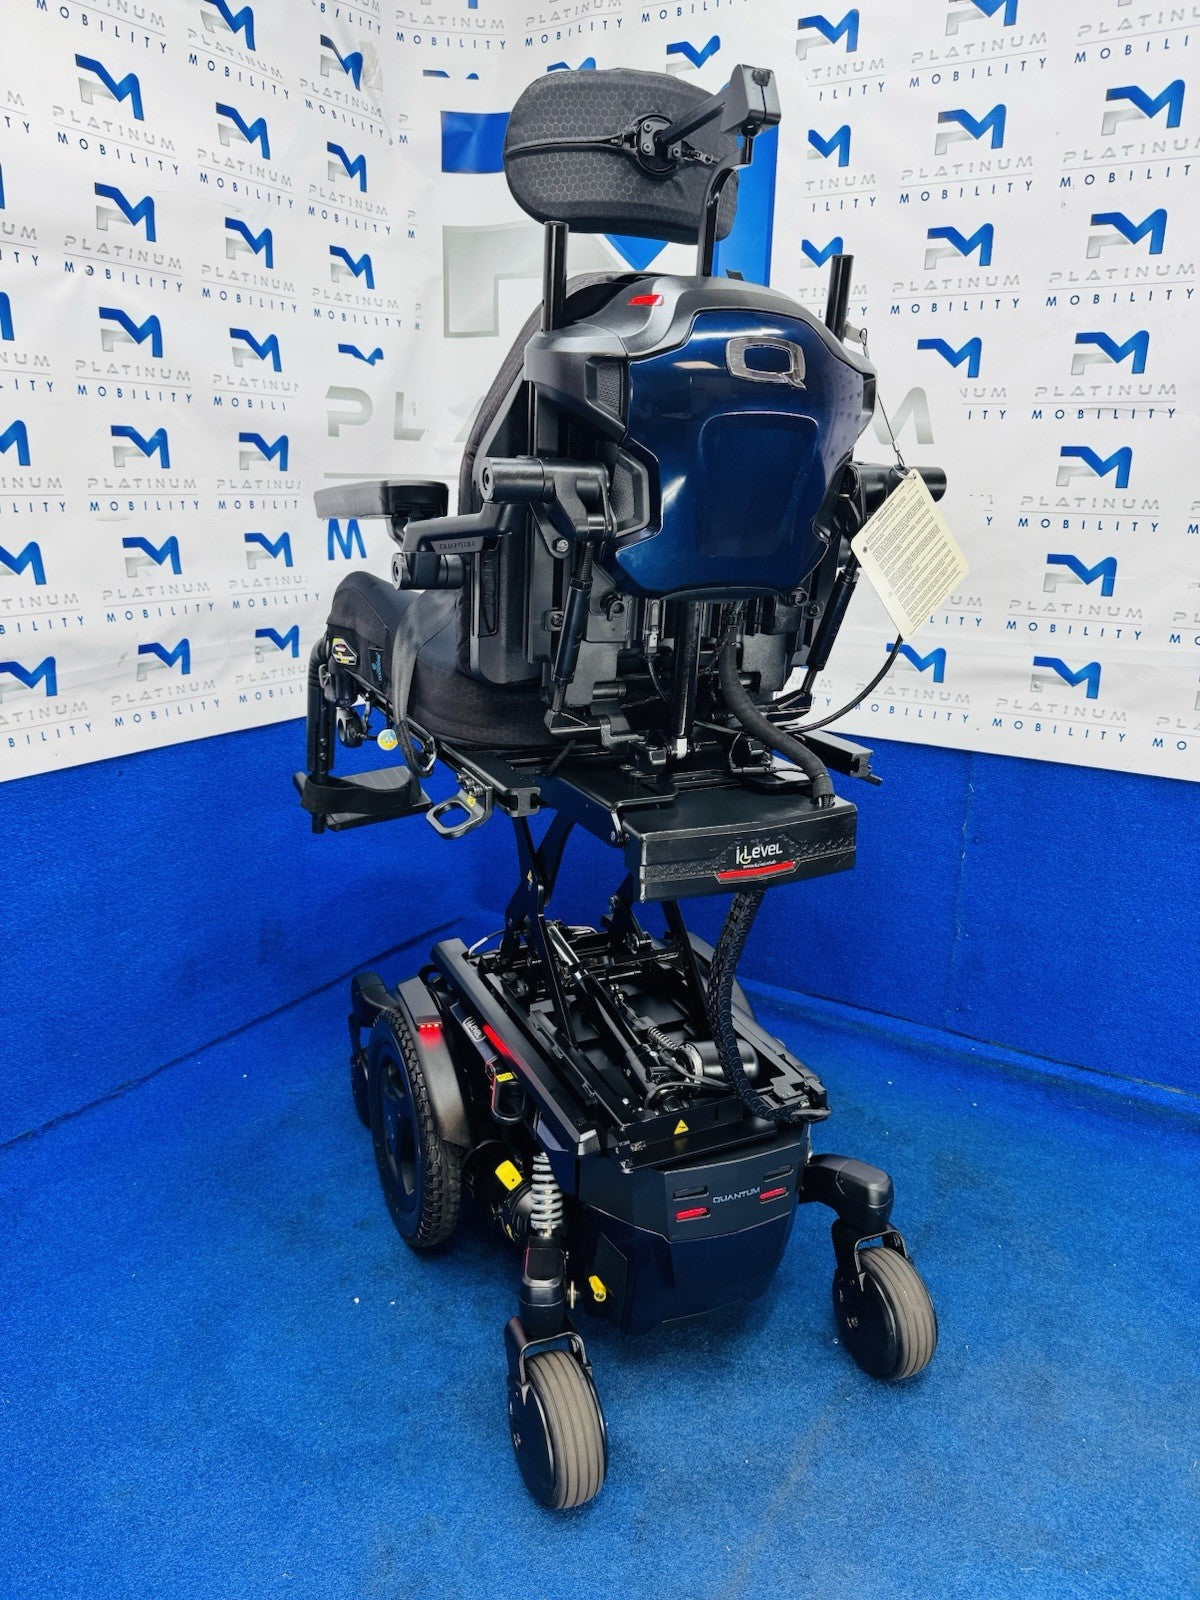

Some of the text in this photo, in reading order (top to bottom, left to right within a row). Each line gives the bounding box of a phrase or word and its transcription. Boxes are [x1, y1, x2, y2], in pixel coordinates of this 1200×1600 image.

[36, 0, 167, 54] MOBILITY
[395, 9, 505, 30] PLATINUM
[396, 32, 507, 50] MOBILITY
[524, 18, 623, 47] MOBILITY
[188, 28, 285, 79] PLATINUM
[911, 32, 1048, 63] PLATINUM
[188, 53, 290, 100] MOBILITY
[909, 57, 1048, 88] MOBILITY
[299, 78, 382, 118] PLATINUM
[52, 105, 176, 151] PLATINUM
[304, 99, 383, 138] MOBILITY
[57, 131, 180, 176] MOBILITY
[197, 148, 293, 187] PLATINUM
[901, 156, 1034, 180] PLATINUM
[199, 172, 294, 209] MOBILITY
[309, 184, 388, 216] PLATINUM
[899, 180, 1033, 204] MOBILITY
[308, 205, 391, 235] MOBILITY
[64, 235, 182, 270] PLATINUM
[64, 261, 183, 293] MOBILITY
[201, 264, 295, 292] PLATINUM
[891, 274, 1021, 293] PLATINUM
[1049, 262, 1196, 283] PLATINUM
[201, 287, 298, 314] MOBILITY
[312, 287, 400, 309] PLATINUM
[890, 298, 1020, 315] MOBILITY
[1046, 288, 1194, 307] MOBILITY
[313, 308, 402, 327] MOBILITY
[75, 359, 191, 382] PLATINUM
[77, 384, 193, 404] MOBILITY
[1034, 384, 1177, 397] PLATINUM
[1031, 408, 1176, 419] MOBILITY
[87, 478, 197, 489] PLATINUM
[90, 500, 200, 511] MOBILITY
[1020, 496, 1160, 510] PLATINUM
[1018, 517, 1159, 533] MOBILITY
[102, 582, 211, 601] PLATINUM
[232, 593, 320, 610] MOBILITY
[106, 602, 215, 623] MOBILITY
[1009, 600, 1143, 618] PLATINUM
[1006, 620, 1141, 640] MOBILITY
[111, 679, 217, 706] PLATINUM
[114, 699, 221, 727] MOBILITY
[996, 698, 1128, 722] PLATINUM
[992, 718, 1126, 742] MOBILITY
[712, 1187, 761, 1204] QUANTUM
